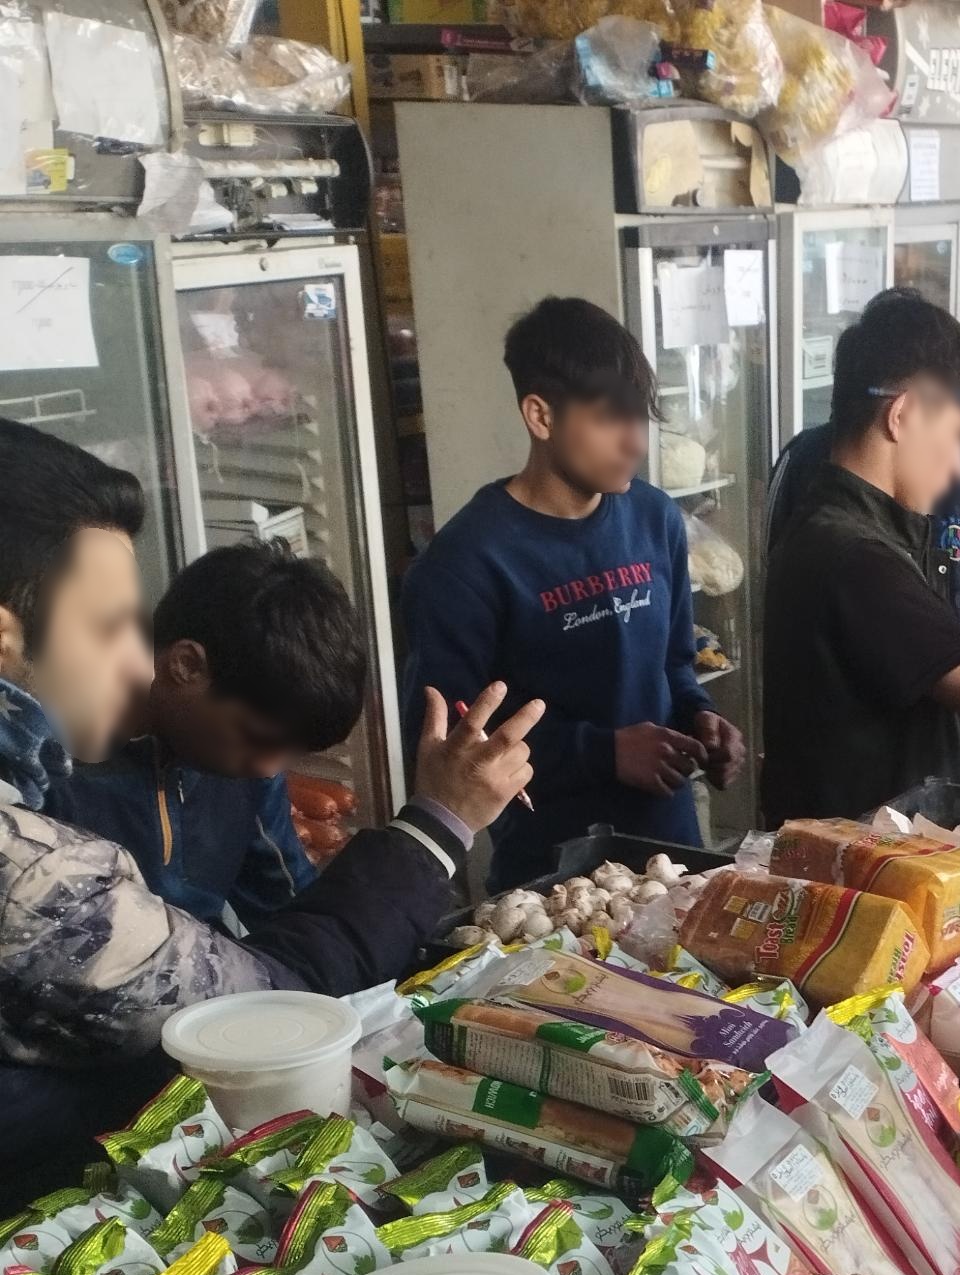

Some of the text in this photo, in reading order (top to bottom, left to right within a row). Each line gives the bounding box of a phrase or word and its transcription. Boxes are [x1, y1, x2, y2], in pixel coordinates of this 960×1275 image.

[540, 563, 652, 613] BURBERRY
[613, 588, 651, 623] England
[755, 921, 786, 961] Toast
[780, 915, 801, 945] Bread
[895, 929, 915, 983] Toast
[722, 1020, 753, 1048] Sandwich
